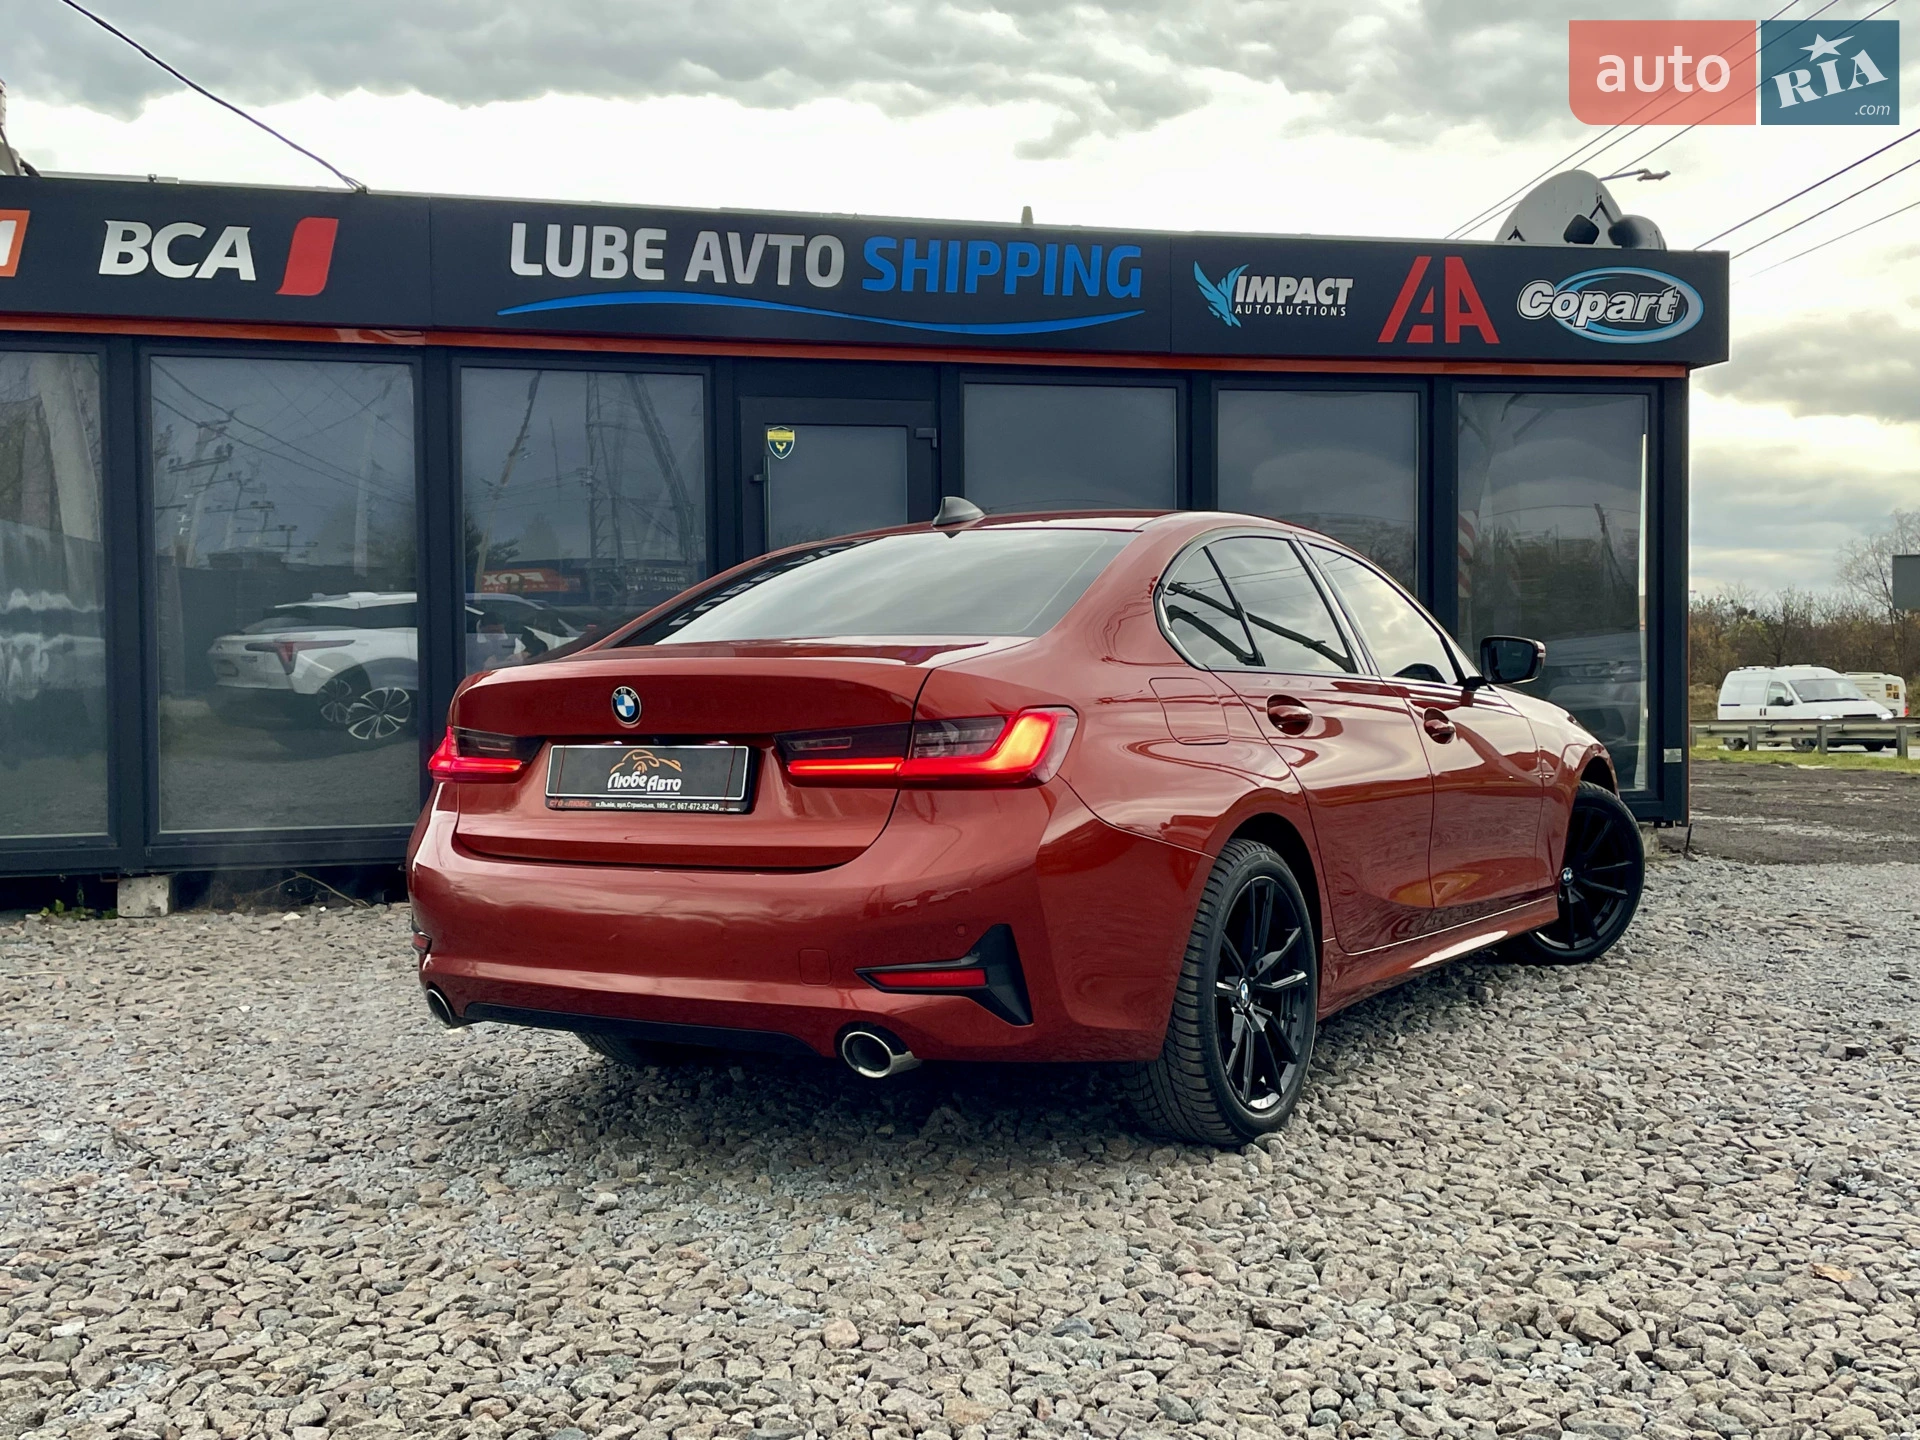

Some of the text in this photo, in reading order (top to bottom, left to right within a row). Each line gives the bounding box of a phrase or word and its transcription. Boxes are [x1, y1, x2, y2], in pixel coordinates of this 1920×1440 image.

[98, 220, 256, 281] BCA
[510, 222, 1143, 299] LUBE AVTO SHIPPING
[1234, 275, 1354, 305] IMPACT
[1517, 279, 1681, 330] Copart
[1234, 304, 1347, 317] AUTO AUCTIONS
[607, 771, 646, 789] Любе
[646, 775, 682, 792] Авто
